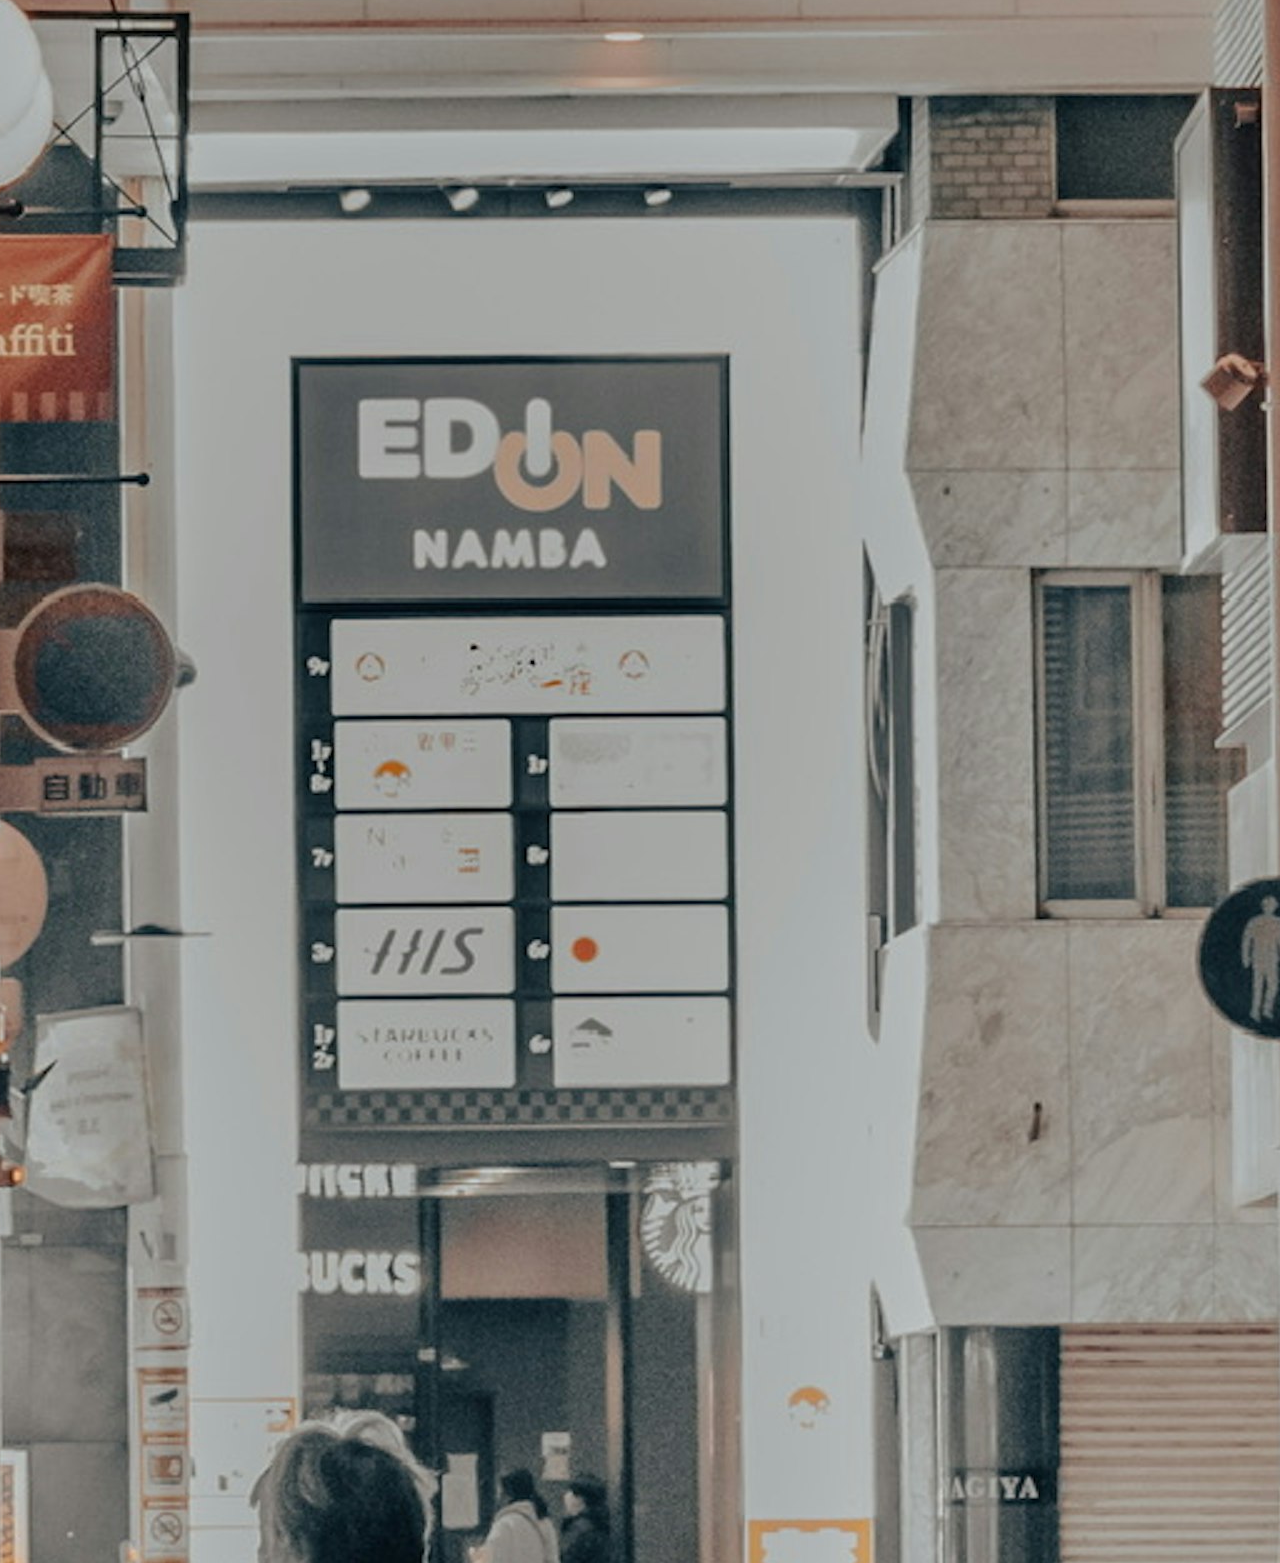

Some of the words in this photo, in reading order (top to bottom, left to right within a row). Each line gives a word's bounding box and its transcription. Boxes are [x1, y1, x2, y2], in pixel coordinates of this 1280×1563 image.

[357, 397, 663, 513] EDION
[412, 527, 608, 571] NAMBA
[44, 773, 141, 801] 自動車
